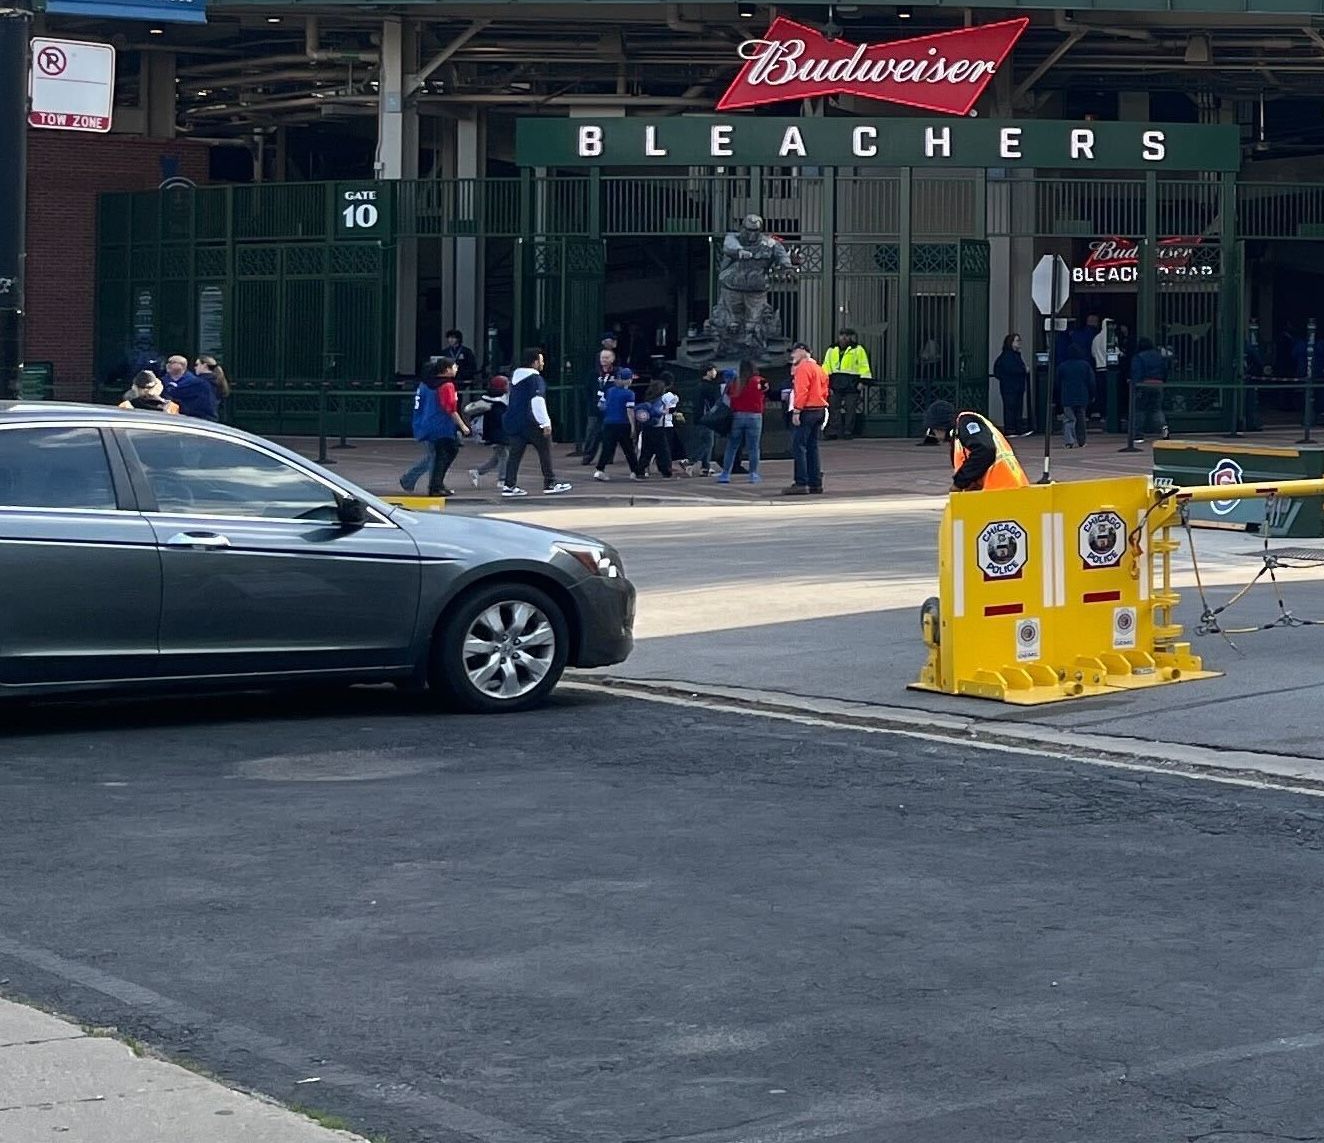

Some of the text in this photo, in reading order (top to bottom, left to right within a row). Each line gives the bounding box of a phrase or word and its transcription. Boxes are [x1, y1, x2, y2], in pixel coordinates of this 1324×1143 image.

[737, 39, 997, 86] Budweiser
[39, 112, 103, 129] TOW ZONE
[577, 125, 1167, 161] BLEACHERS
[344, 190, 378, 201] GATE
[342, 204, 378, 228] 10
[982, 523, 1022, 543] CHICAGO
[1083, 514, 1122, 533] CHICAGO
[1086, 550, 1118, 564] POLICE
[986, 561, 1020, 574] POLICE
